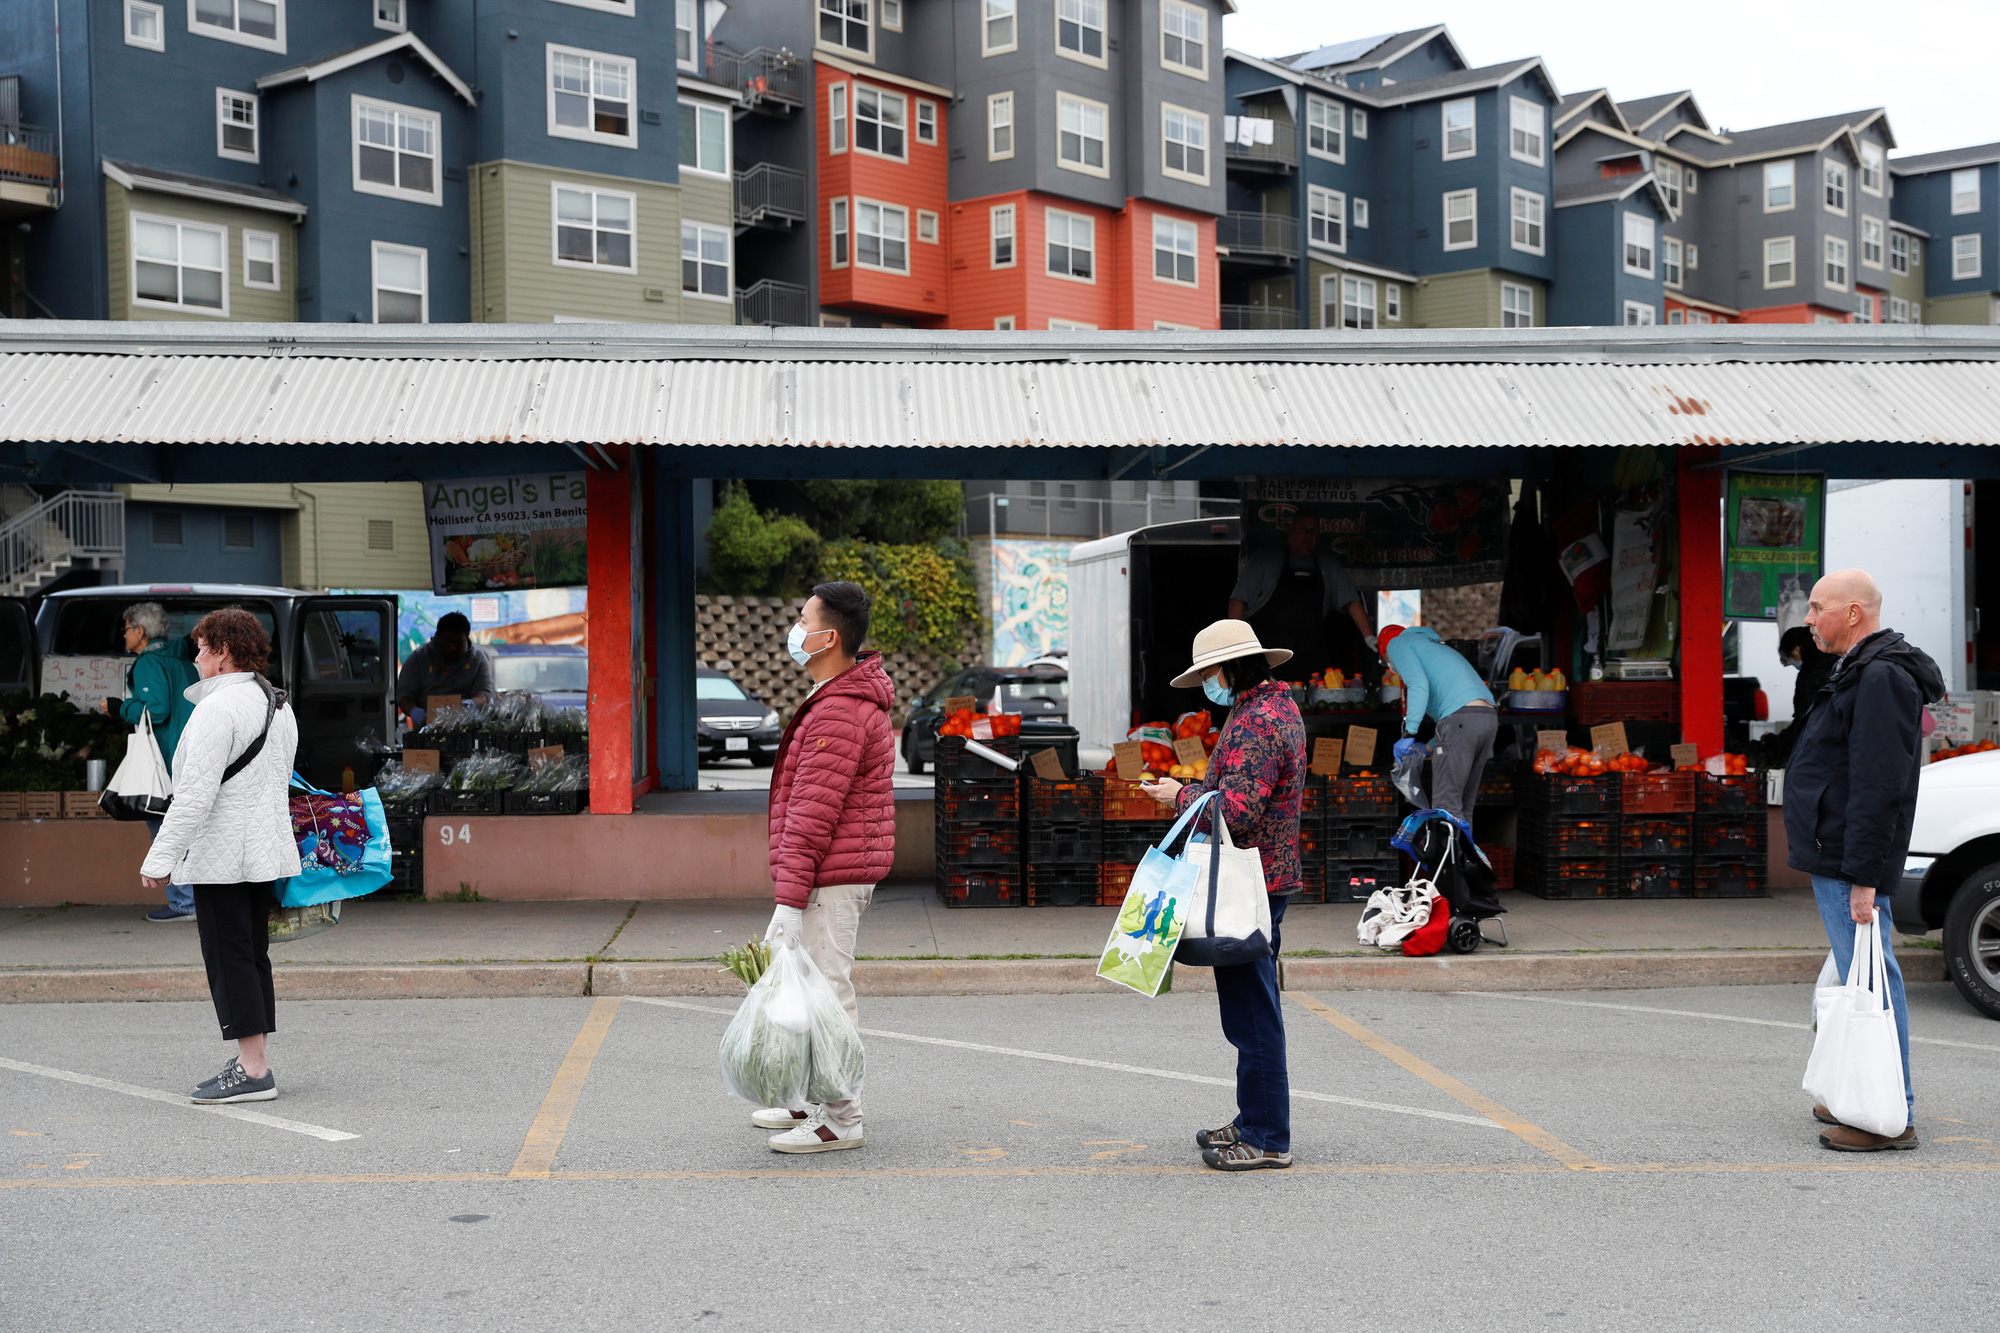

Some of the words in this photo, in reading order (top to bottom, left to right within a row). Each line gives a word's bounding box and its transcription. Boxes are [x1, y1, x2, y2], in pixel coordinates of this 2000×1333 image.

[430, 477, 539, 513] Angel's
[548, 475, 587, 502] Fa
[1256, 489, 1301, 499] FINEST
[1307, 490, 1357, 500] CITRUS
[1259, 479, 1353, 490] CALIFORNIA'S
[430, 514, 475, 526] Hollister
[477, 513, 491, 523] CA
[494, 511, 530, 522] 95023,
[533, 509, 552, 519] San
[475, 524, 491, 535] We
[493, 522, 520, 534] Grow
[522, 520, 548, 531] What
[550, 519, 566, 529] We
[568, 517, 586, 527] Sell
[1331, 536, 1435, 562] Ranches
[46, 660, 62, 682] 3
[440, 823, 472, 846] 94
